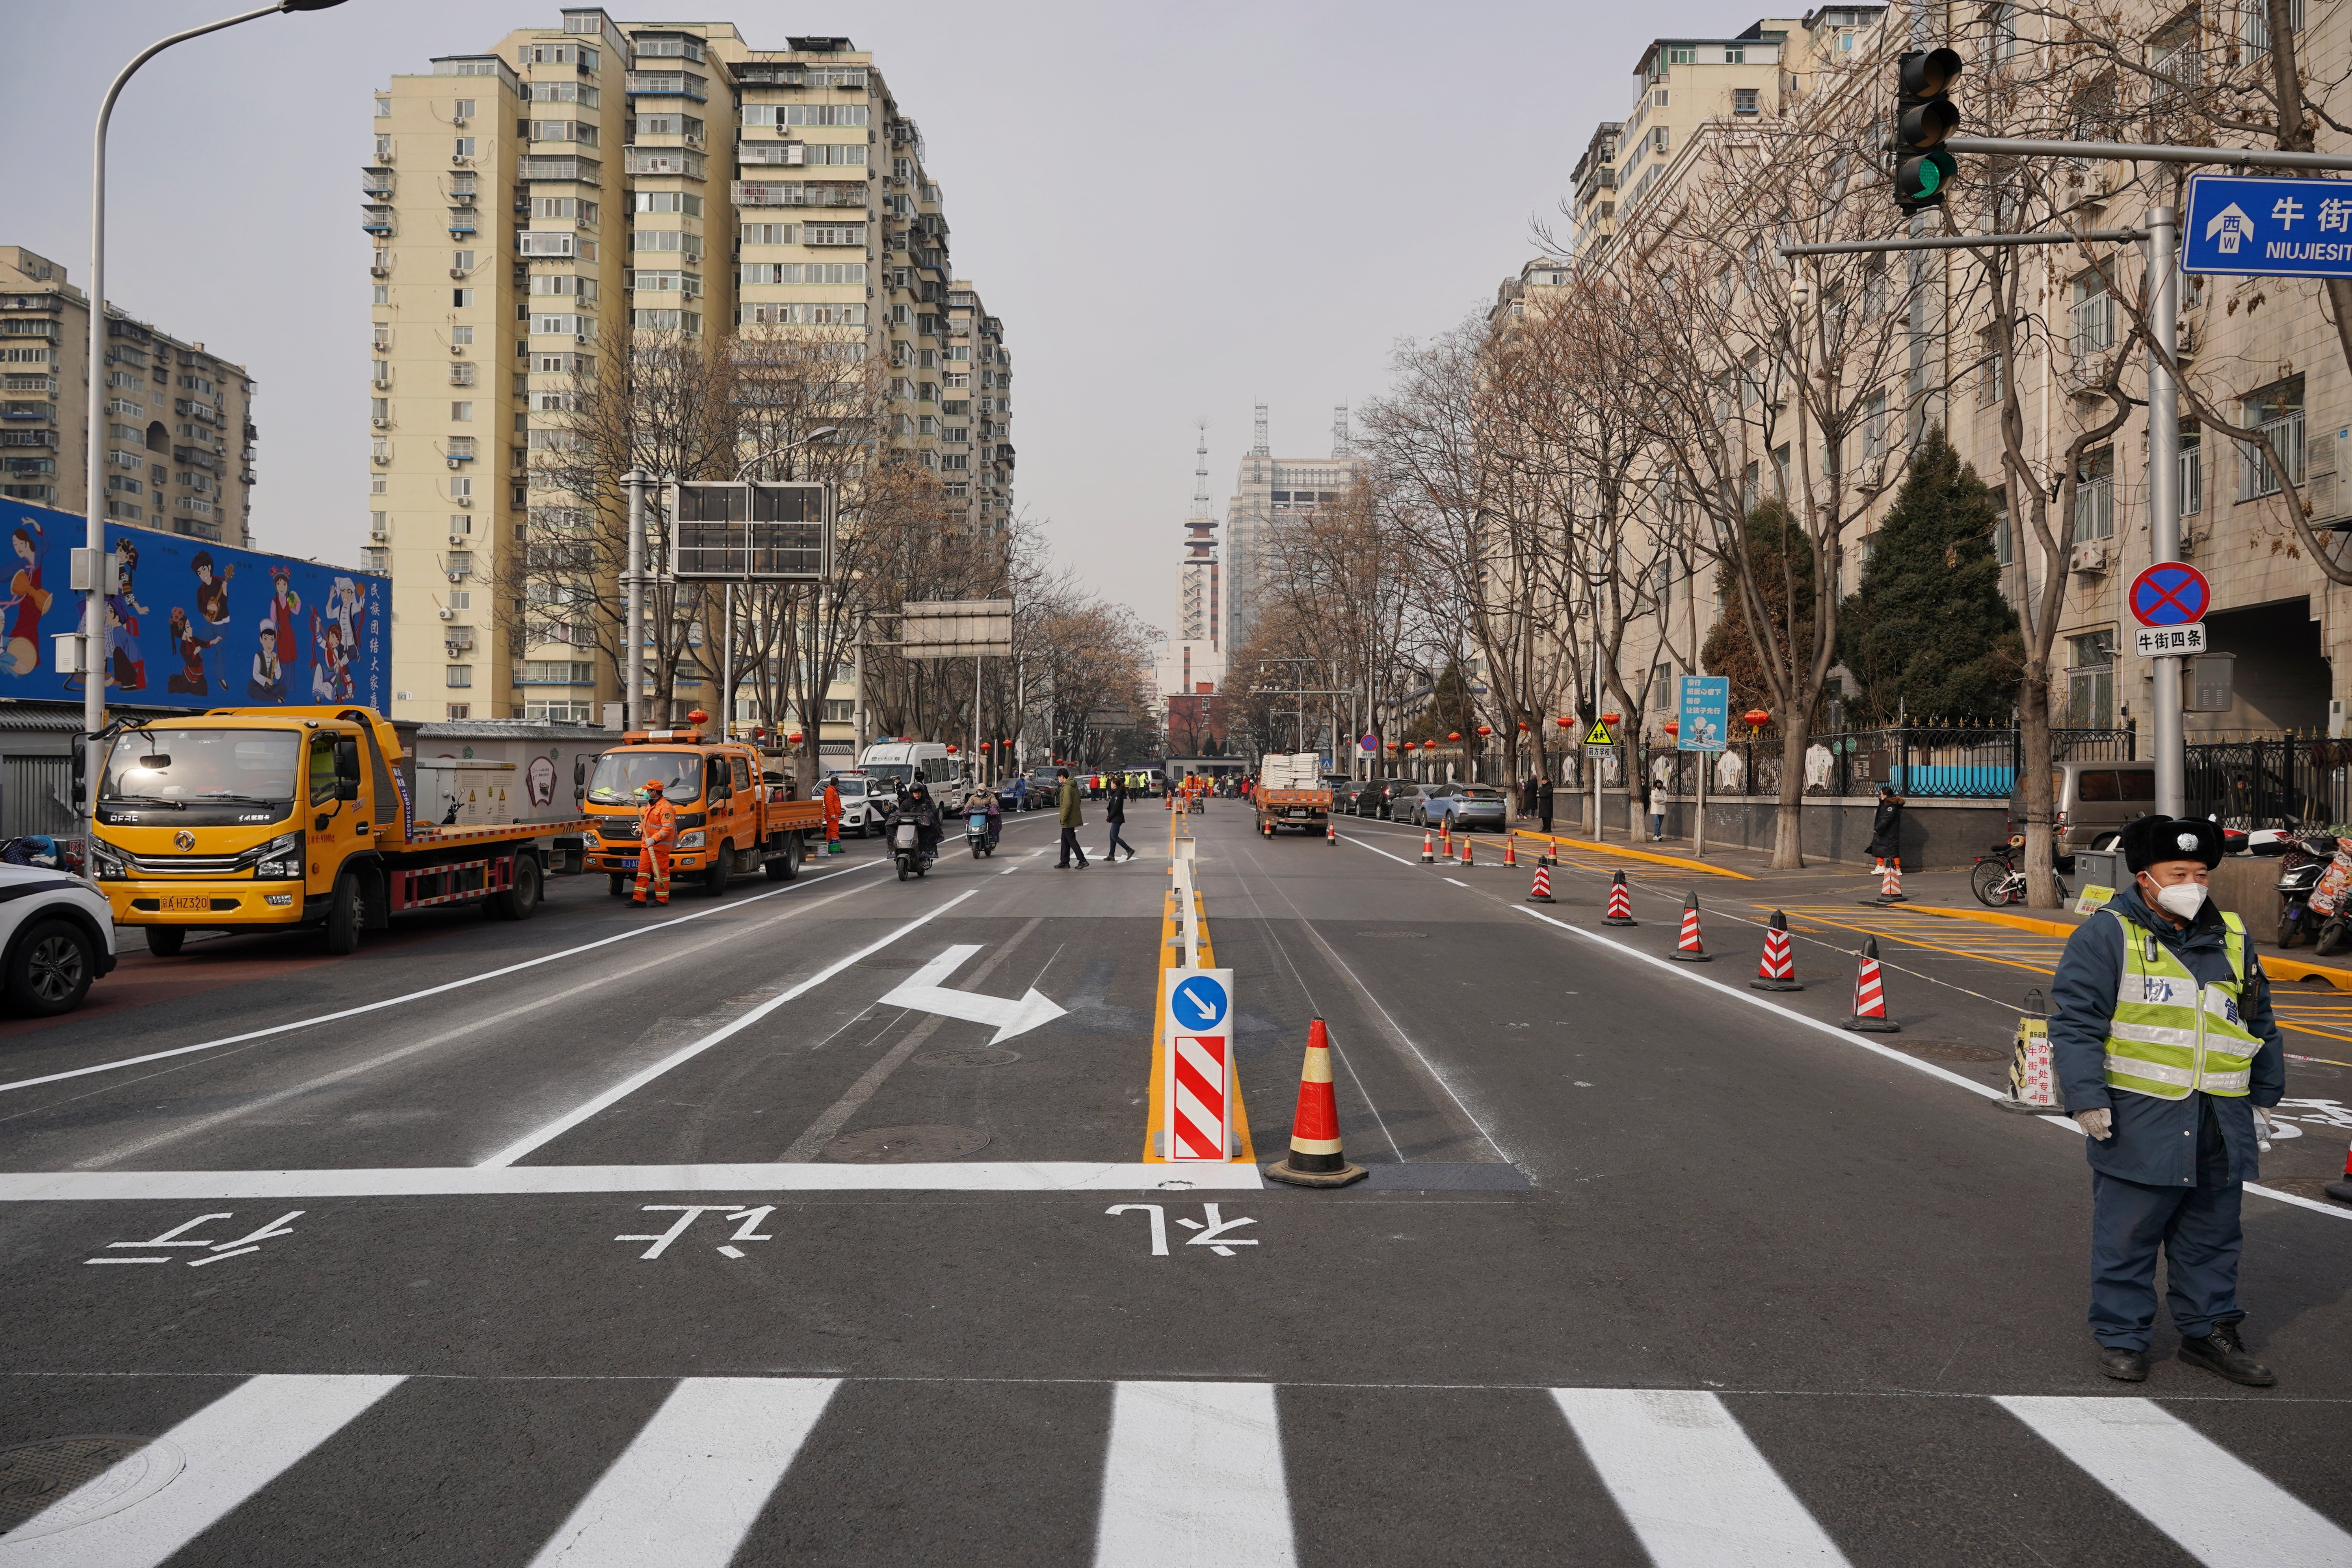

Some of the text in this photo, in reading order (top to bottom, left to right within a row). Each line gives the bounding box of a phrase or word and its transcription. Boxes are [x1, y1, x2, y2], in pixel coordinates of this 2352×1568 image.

[2223, 215, 2241, 233] 西
[2224, 237, 2236, 249] W
[2266, 241, 2352, 261] NIUJIESIT
[370, 583, 380, 709] 民族团结大家庭
[2139, 629, 2201, 651] 牛街四条
[1589, 747, 1610, 756] 前方学校
[401, 789, 412, 837] 13693348639
[162, 898, 207, 908] 京A·HZ320
[2146, 978, 2174, 1002] 协
[2038, 1044, 2049, 1103] 办事处专用
